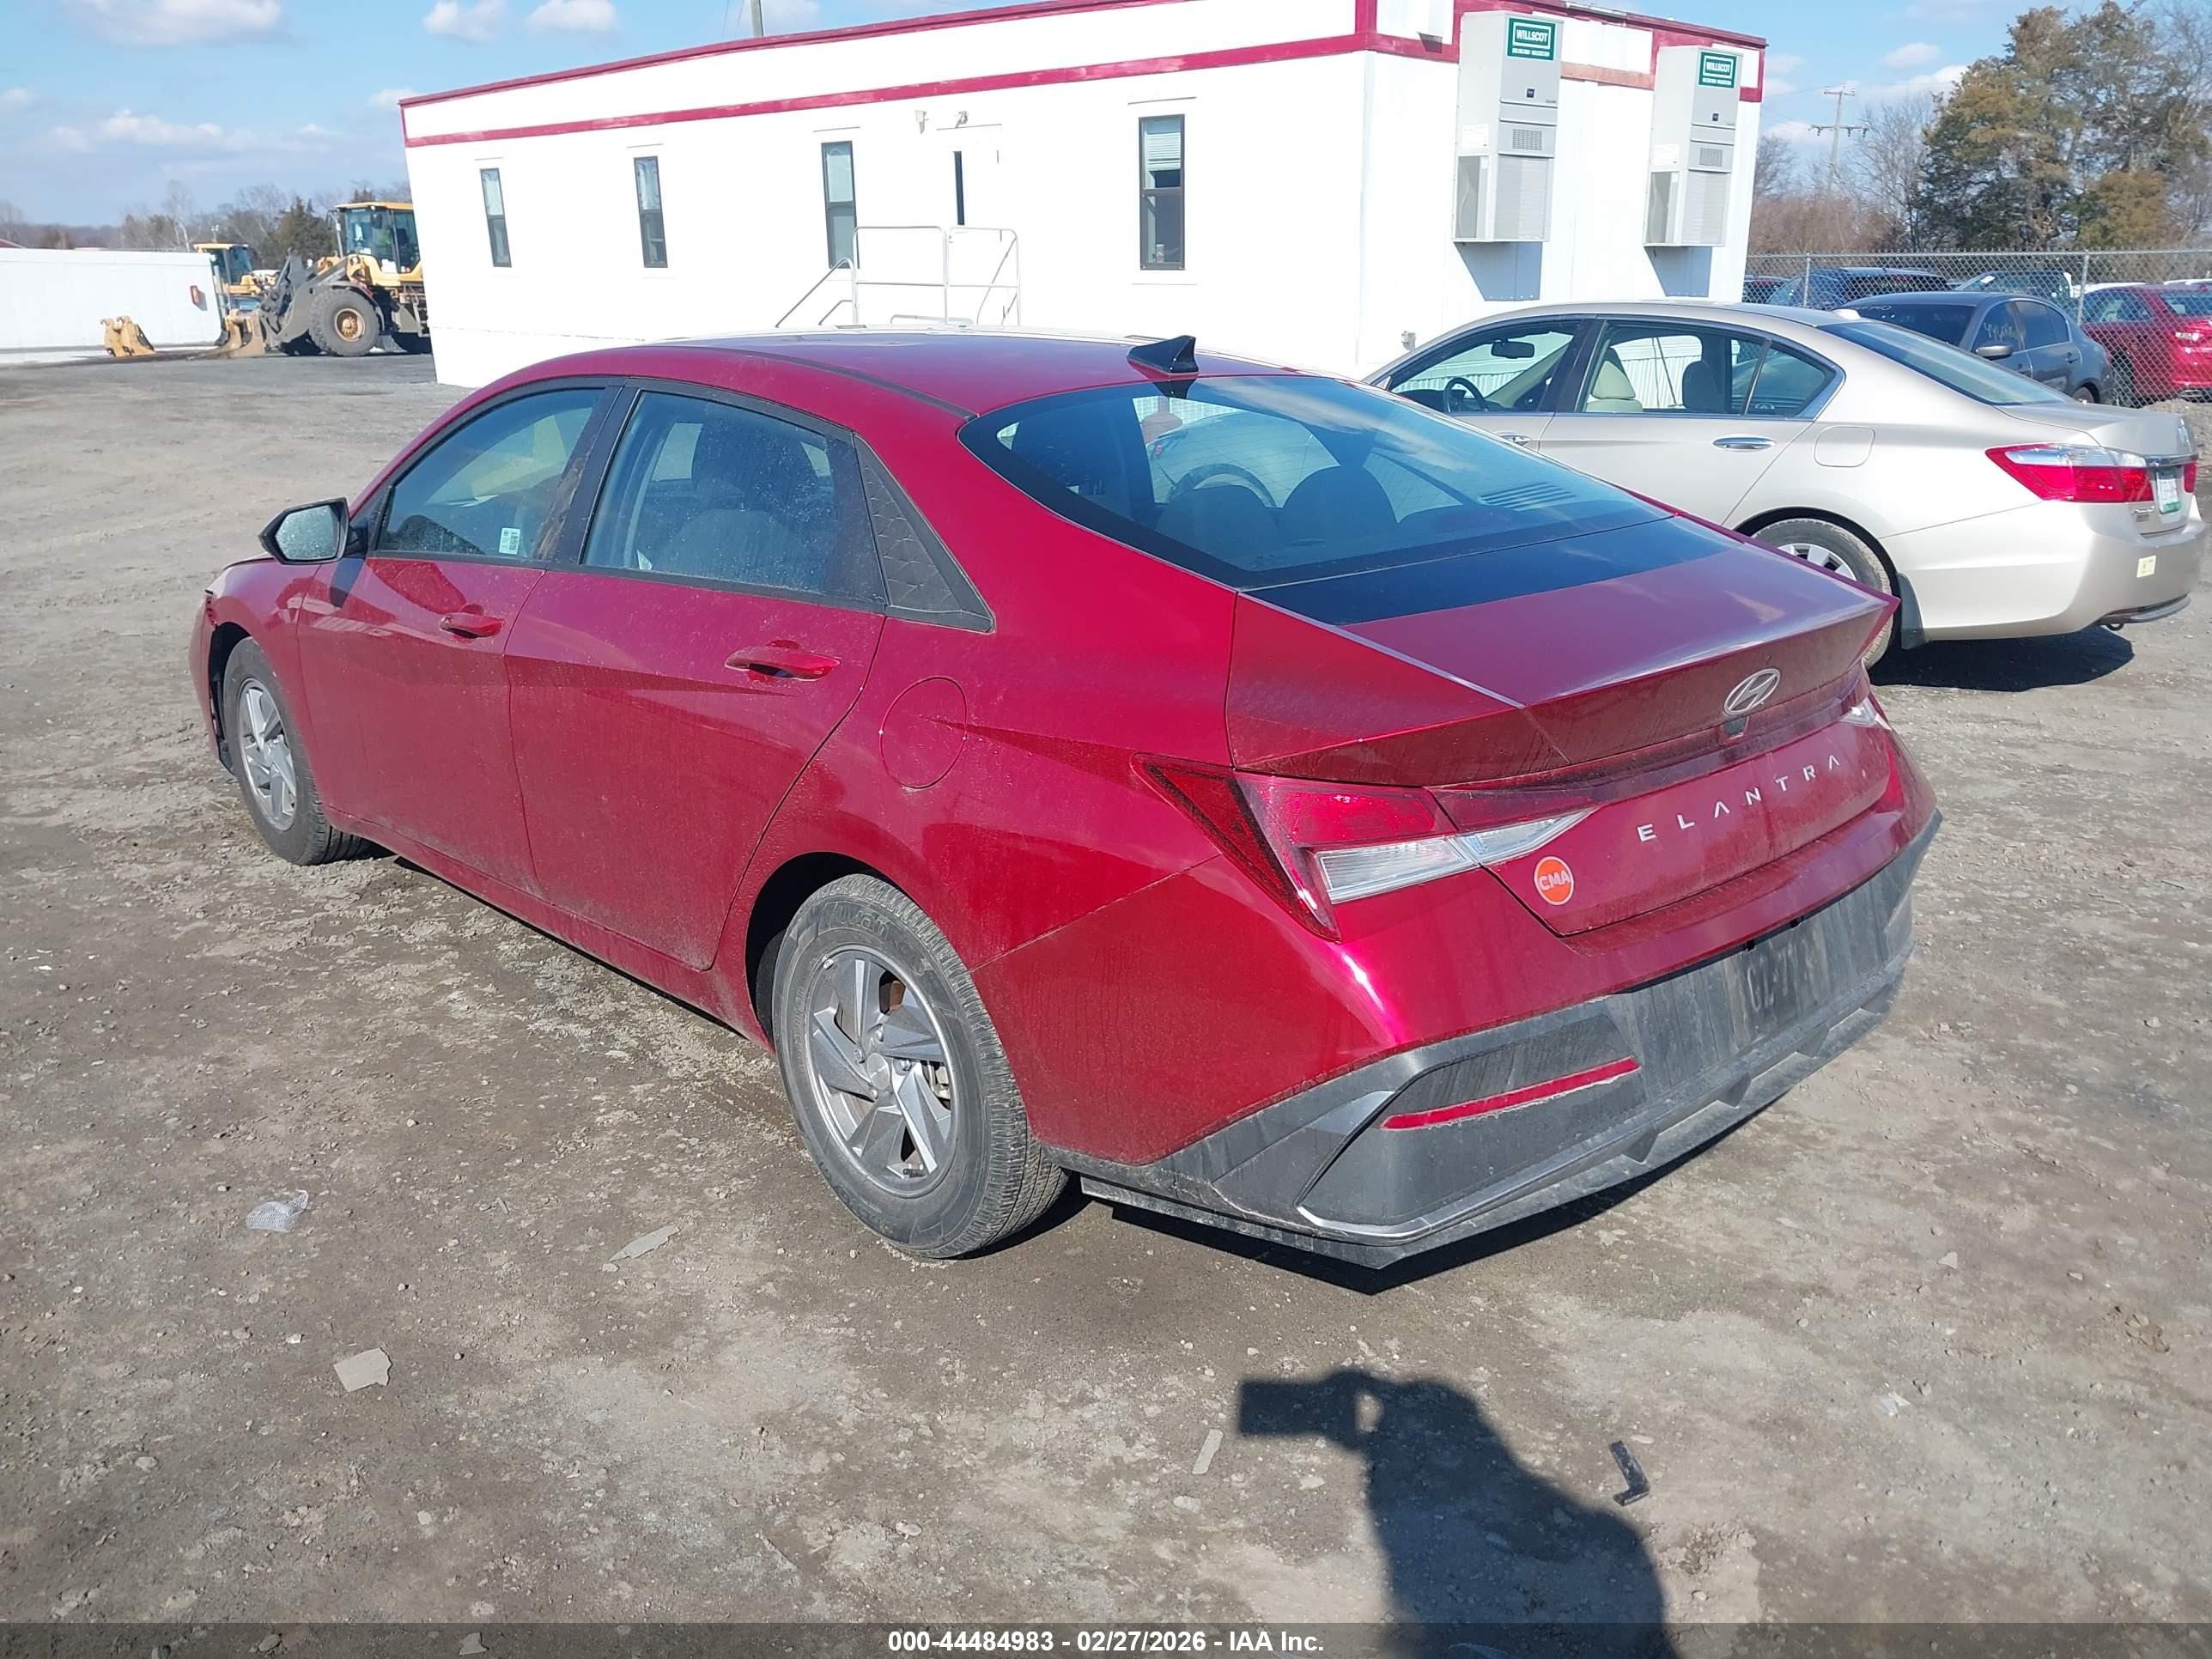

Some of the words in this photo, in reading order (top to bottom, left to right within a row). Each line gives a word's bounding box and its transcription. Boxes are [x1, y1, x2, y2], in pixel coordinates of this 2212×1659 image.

[1516, 28, 1548, 43] WILLSCOT
[1637, 755, 1840, 842] ELANTRA
[1538, 869, 1571, 891] CMA
